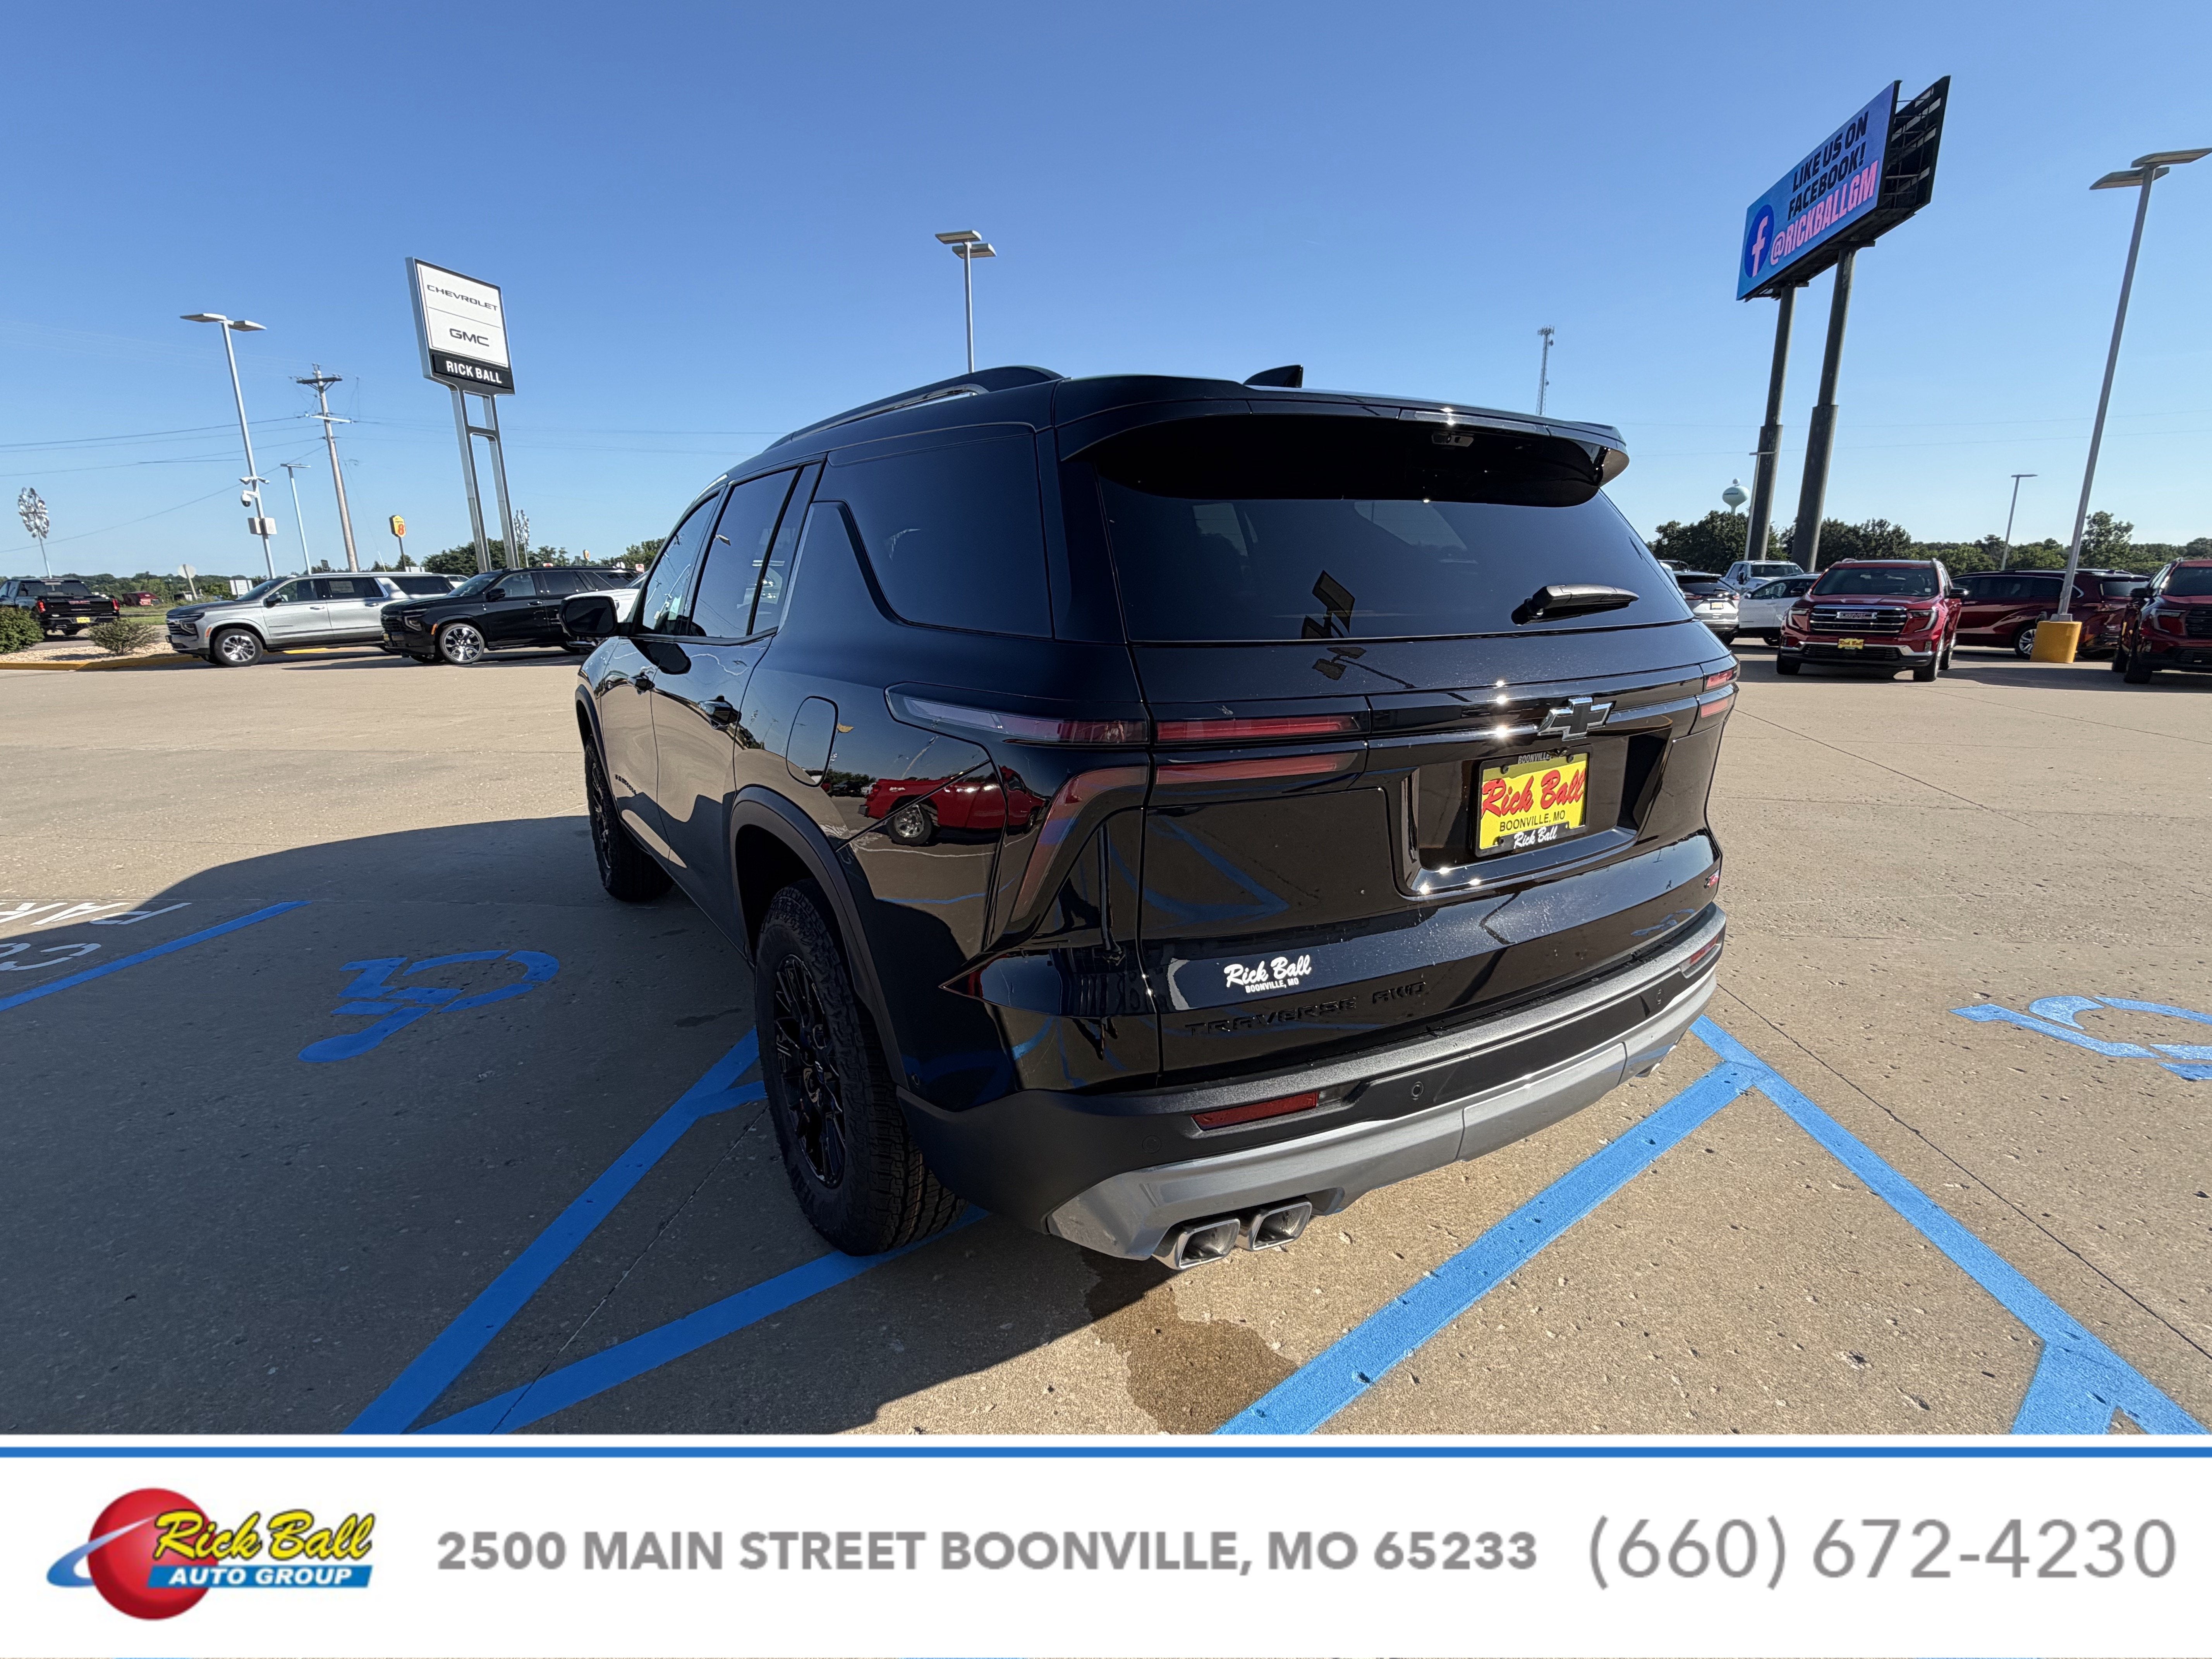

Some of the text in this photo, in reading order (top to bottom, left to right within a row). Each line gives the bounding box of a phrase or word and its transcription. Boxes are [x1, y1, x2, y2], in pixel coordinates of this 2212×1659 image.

[1793, 111, 1869, 193] LIKE US ON
[1788, 142, 1866, 221] FACEBOOK!
[1770, 160, 1878, 265] @RICKBALLGM
[427, 284, 498, 311] CHEVROLET
[450, 328, 489, 347] GMC
[446, 361, 502, 384] RICK BALL
[398, 524, 404, 535] 8
[1481, 768, 1586, 817] Rick Ball
[1499, 810, 1565, 831] BOONVILLE, MO
[1514, 825, 1558, 849] Rick Ball
[1224, 955, 1312, 988] Rick Ball
[1245, 977, 1299, 993] BOONVILLE, MO
[1185, 981, 1427, 1036] TRAVERSE AWD
